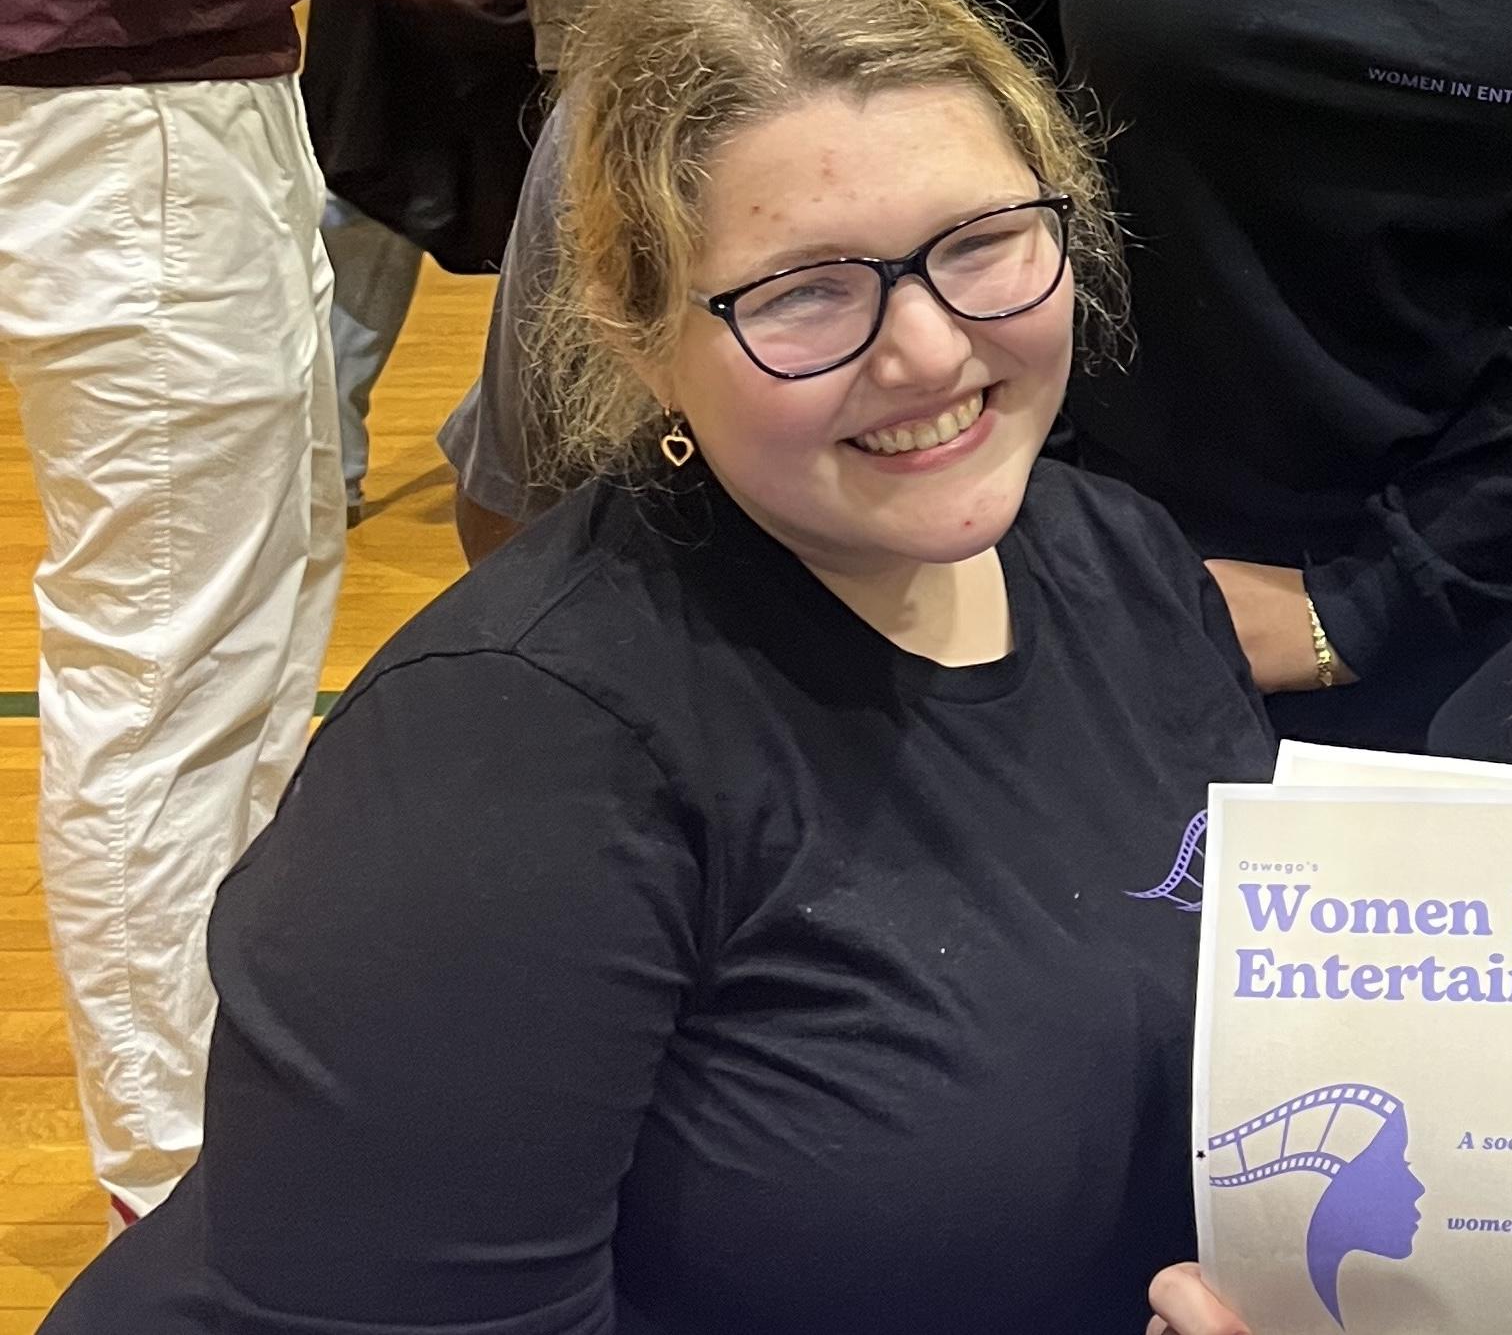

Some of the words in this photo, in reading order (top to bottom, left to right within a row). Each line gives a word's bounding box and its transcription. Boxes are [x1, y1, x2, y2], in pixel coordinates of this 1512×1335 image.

[1367, 66, 1444, 94] WOMEN
[1450, 81, 1472, 98] IN
[1238, 860, 1319, 875] Oswego's
[1238, 883, 1494, 936] Women
[1456, 1131, 1474, 1150] A
